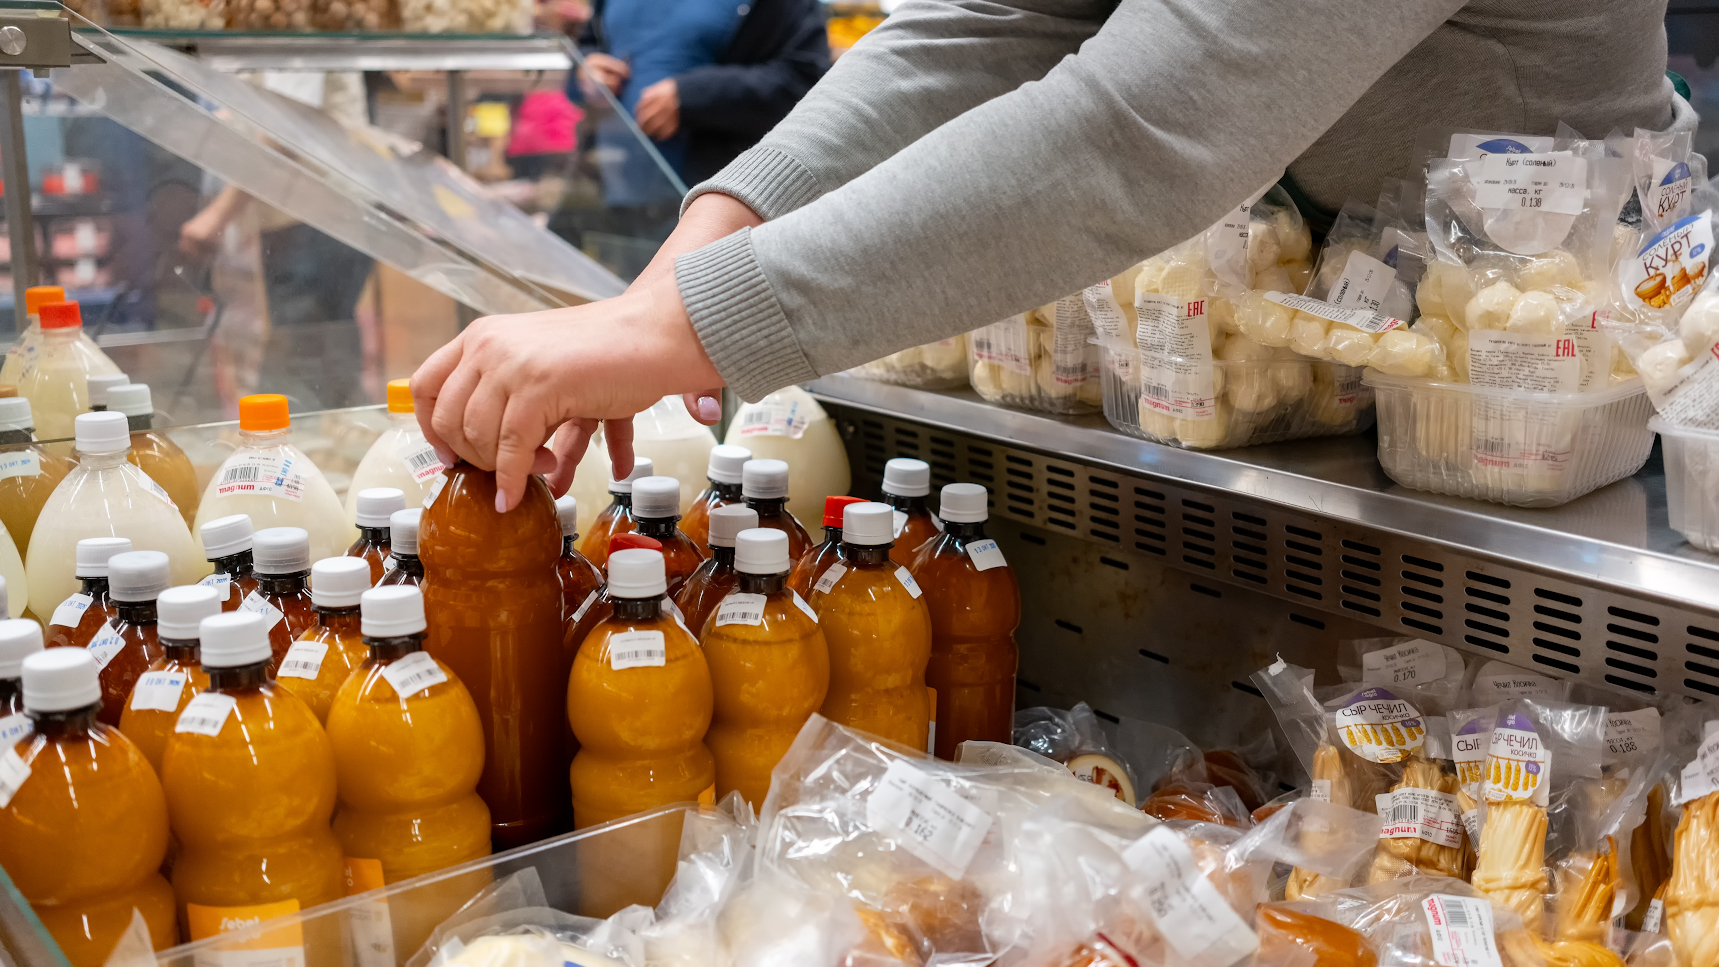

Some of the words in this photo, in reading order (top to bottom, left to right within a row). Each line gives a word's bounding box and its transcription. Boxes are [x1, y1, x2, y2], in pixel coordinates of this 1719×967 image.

[1505, 158, 1519, 167] Курт
[1658, 190, 1686, 213] КУРТ
[1643, 231, 1692, 276] КУРТ
[1188, 300, 1204, 317] EAC
[1144, 397, 1170, 411] magnum
[417, 464, 446, 479] magnu
[219, 484, 255, 494] magnum
[1394, 670, 1415, 682] 0.170
[1513, 680, 1537, 688] Косичка
[1342, 705, 1367, 717] СЫР
[1369, 703, 1407, 714] ЧЕЧИЛ
[1382, 713, 1410, 721] косичка
[1503, 734, 1538, 751] ЧЕЧИЛ
[1609, 741, 1637, 754] 0.188
[1510, 748, 1537, 759] косичка
[1427, 898, 1442, 925] magnum
